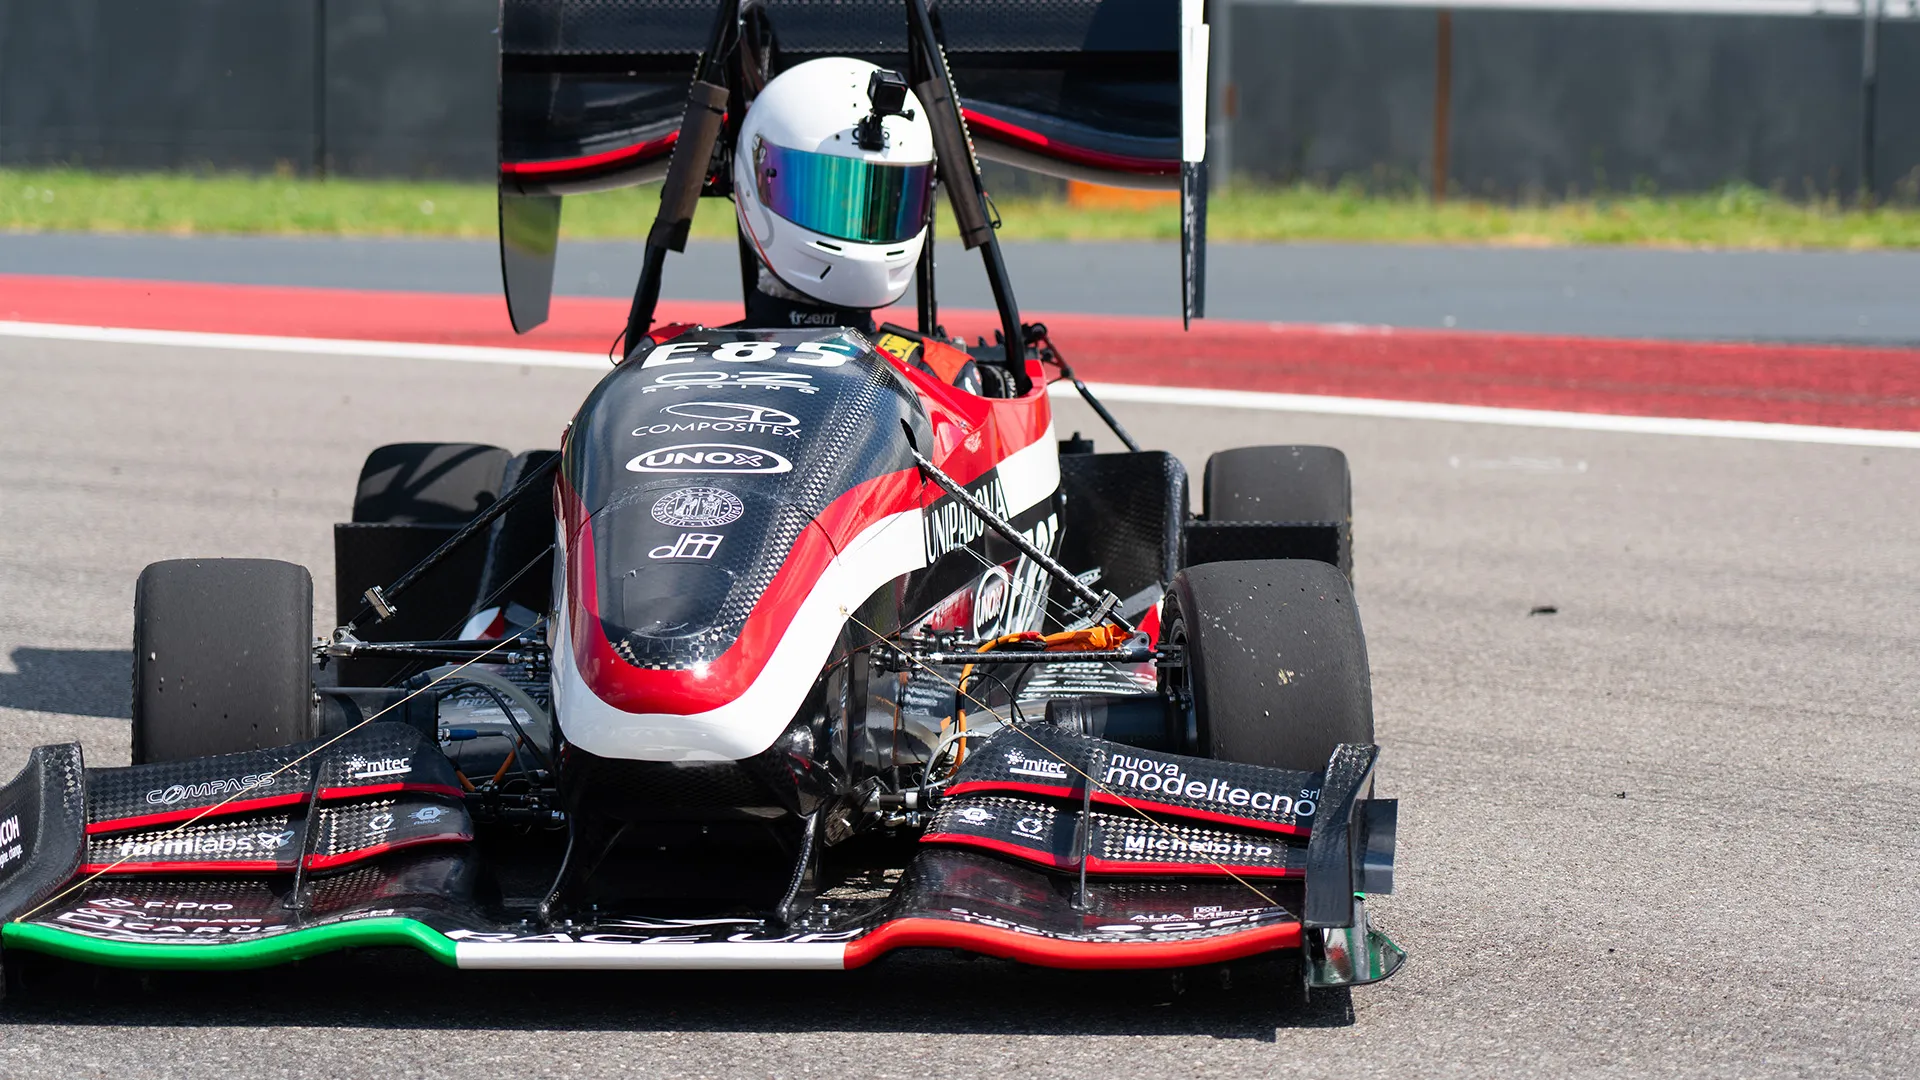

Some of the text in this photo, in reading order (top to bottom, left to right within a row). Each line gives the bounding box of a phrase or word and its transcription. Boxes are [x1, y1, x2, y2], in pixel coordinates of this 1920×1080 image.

[641, 341, 851, 369] E85
[631, 421, 802, 438] COMPOSITEX
[646, 452, 763, 467] UNOX
[924, 478, 1009, 564] UNIPADOVA
[367, 757, 410, 773] mitec
[1022, 759, 1066, 774] mitec
[1111, 754, 1179, 777] nuova
[146, 772, 275, 805] COMPASS
[1105, 766, 1316, 817] modeltecno
[1300, 788, 1321, 800] srl
[120, 834, 252, 857] formlabs
[1124, 835, 1273, 857] Michelotto
[143, 901, 234, 911] F-Pro
[443, 927, 864, 944] RACE UP
